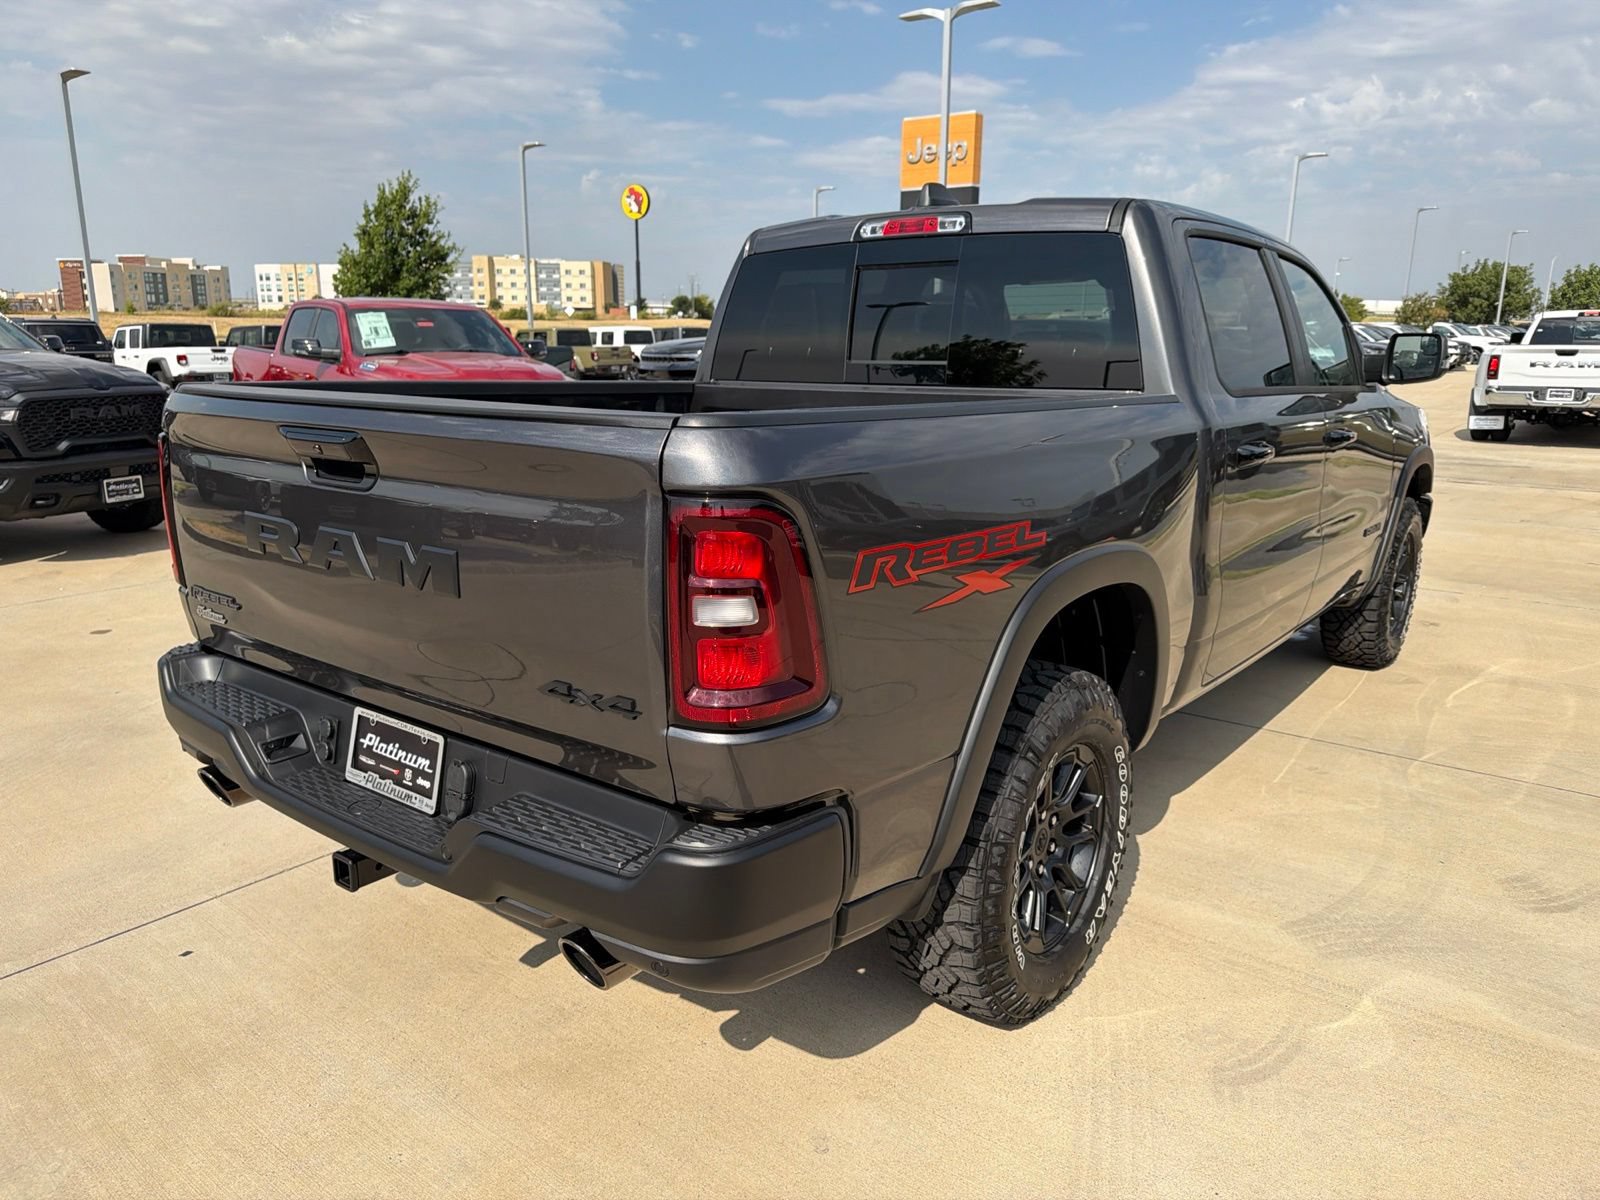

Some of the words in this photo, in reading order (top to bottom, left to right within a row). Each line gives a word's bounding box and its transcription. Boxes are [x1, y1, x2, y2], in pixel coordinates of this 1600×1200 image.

[906, 137, 968, 167] Jep
[243, 509, 462, 599] RAM
[847, 520, 1047, 595] REBEL
[191, 584, 243, 611] REBEL
[360, 732, 433, 773] Platinum
[364, 772, 417, 805] Platinum
[1085, 745, 1129, 944] GOODYEAR
